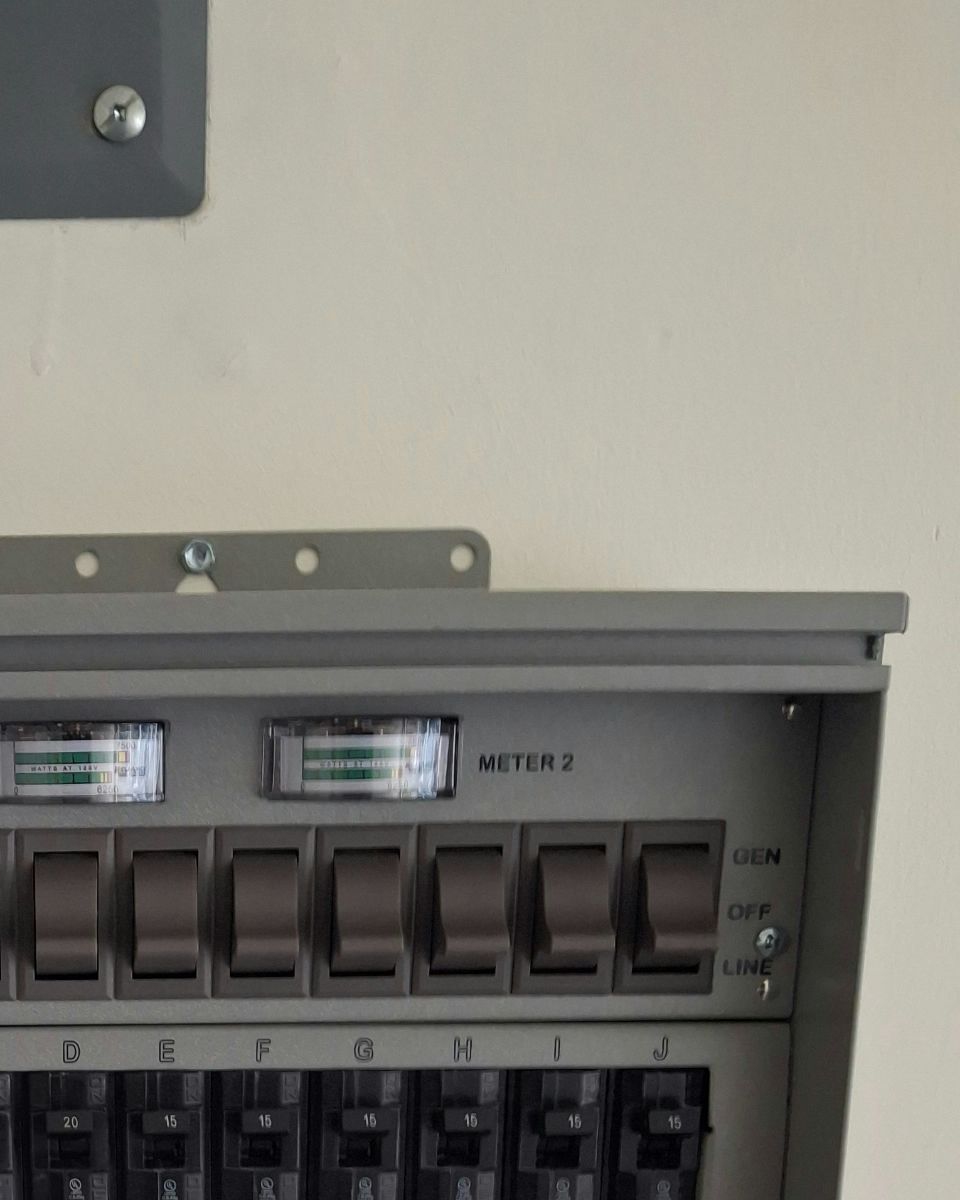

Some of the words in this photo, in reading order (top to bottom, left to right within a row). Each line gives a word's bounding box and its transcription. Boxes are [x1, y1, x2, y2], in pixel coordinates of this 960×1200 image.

[479, 752, 555, 774] METER
[561, 752, 574, 773] 2
[733, 848, 781, 865] GEN
[727, 904, 772, 920] OFF
[722, 958, 773, 976] LINE
[62, 1040, 80, 1063] D
[158, 1039, 175, 1063] E
[255, 1038, 271, 1062] F
[353, 1038, 374, 1062] G
[453, 1037, 473, 1062] H
[553, 1036, 561, 1062] I
[653, 1037, 669, 1062] J
[63, 1116, 79, 1128] 20
[164, 1115, 177, 1128] 15
[258, 1114, 272, 1127] 15
[363, 1113, 377, 1127] 15
[464, 1113, 478, 1128] 15
[568, 1114, 582, 1128] 15
[668, 1115, 682, 1129] 15
